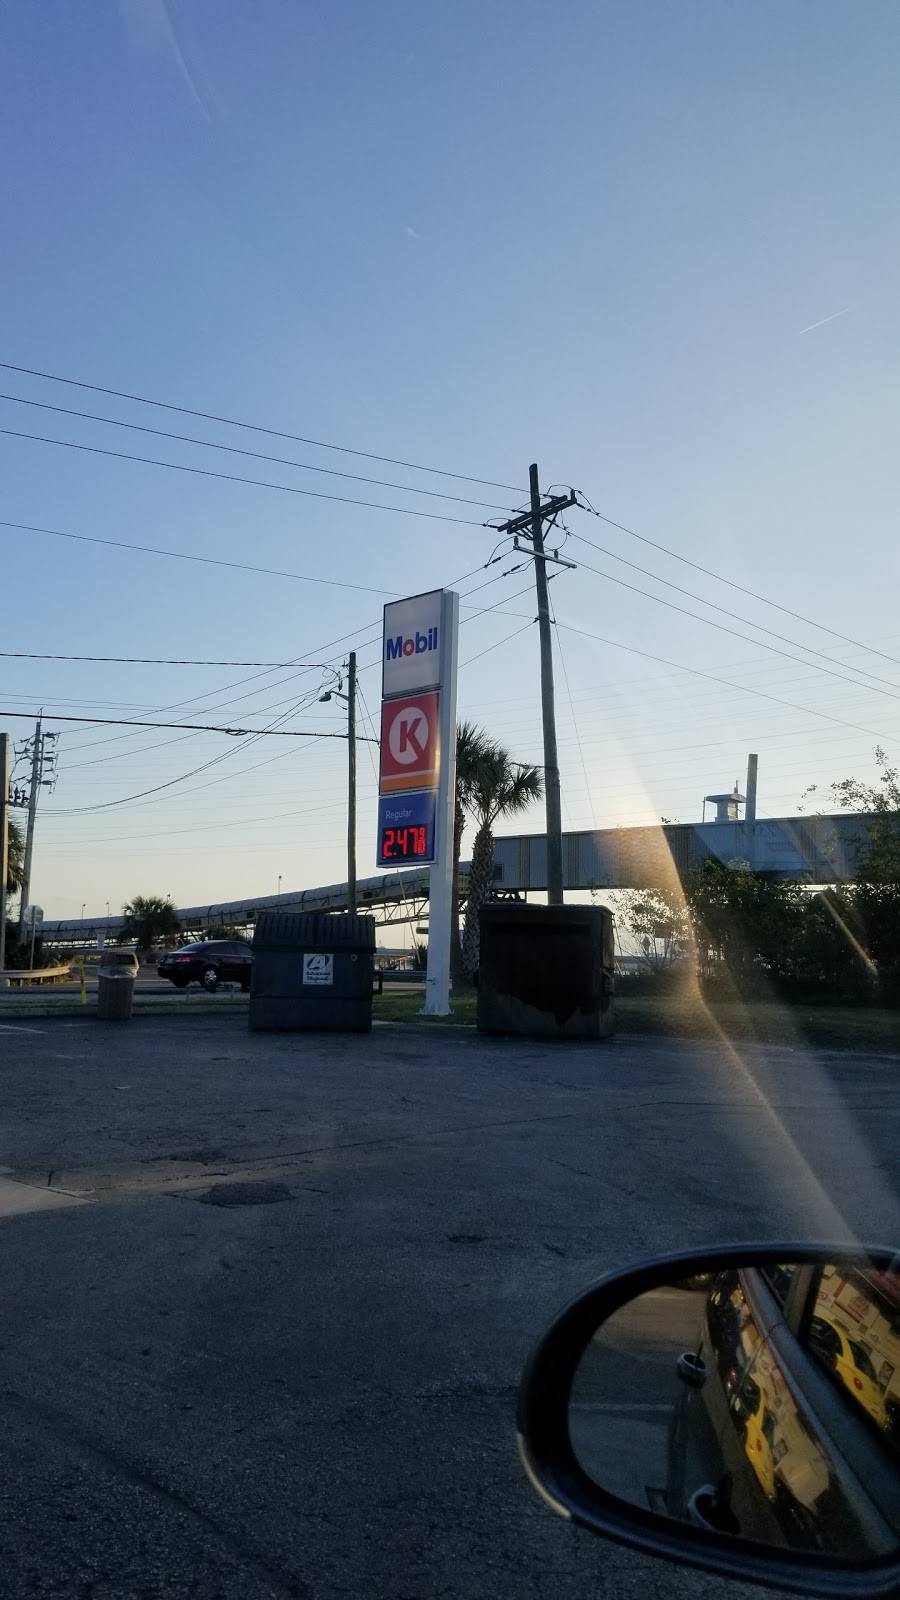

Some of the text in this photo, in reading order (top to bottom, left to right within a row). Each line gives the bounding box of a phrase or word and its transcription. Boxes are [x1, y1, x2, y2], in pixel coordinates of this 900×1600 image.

[386, 626, 438, 661] Mobil
[400, 717, 427, 760] K
[386, 808, 412, 821] Regular
